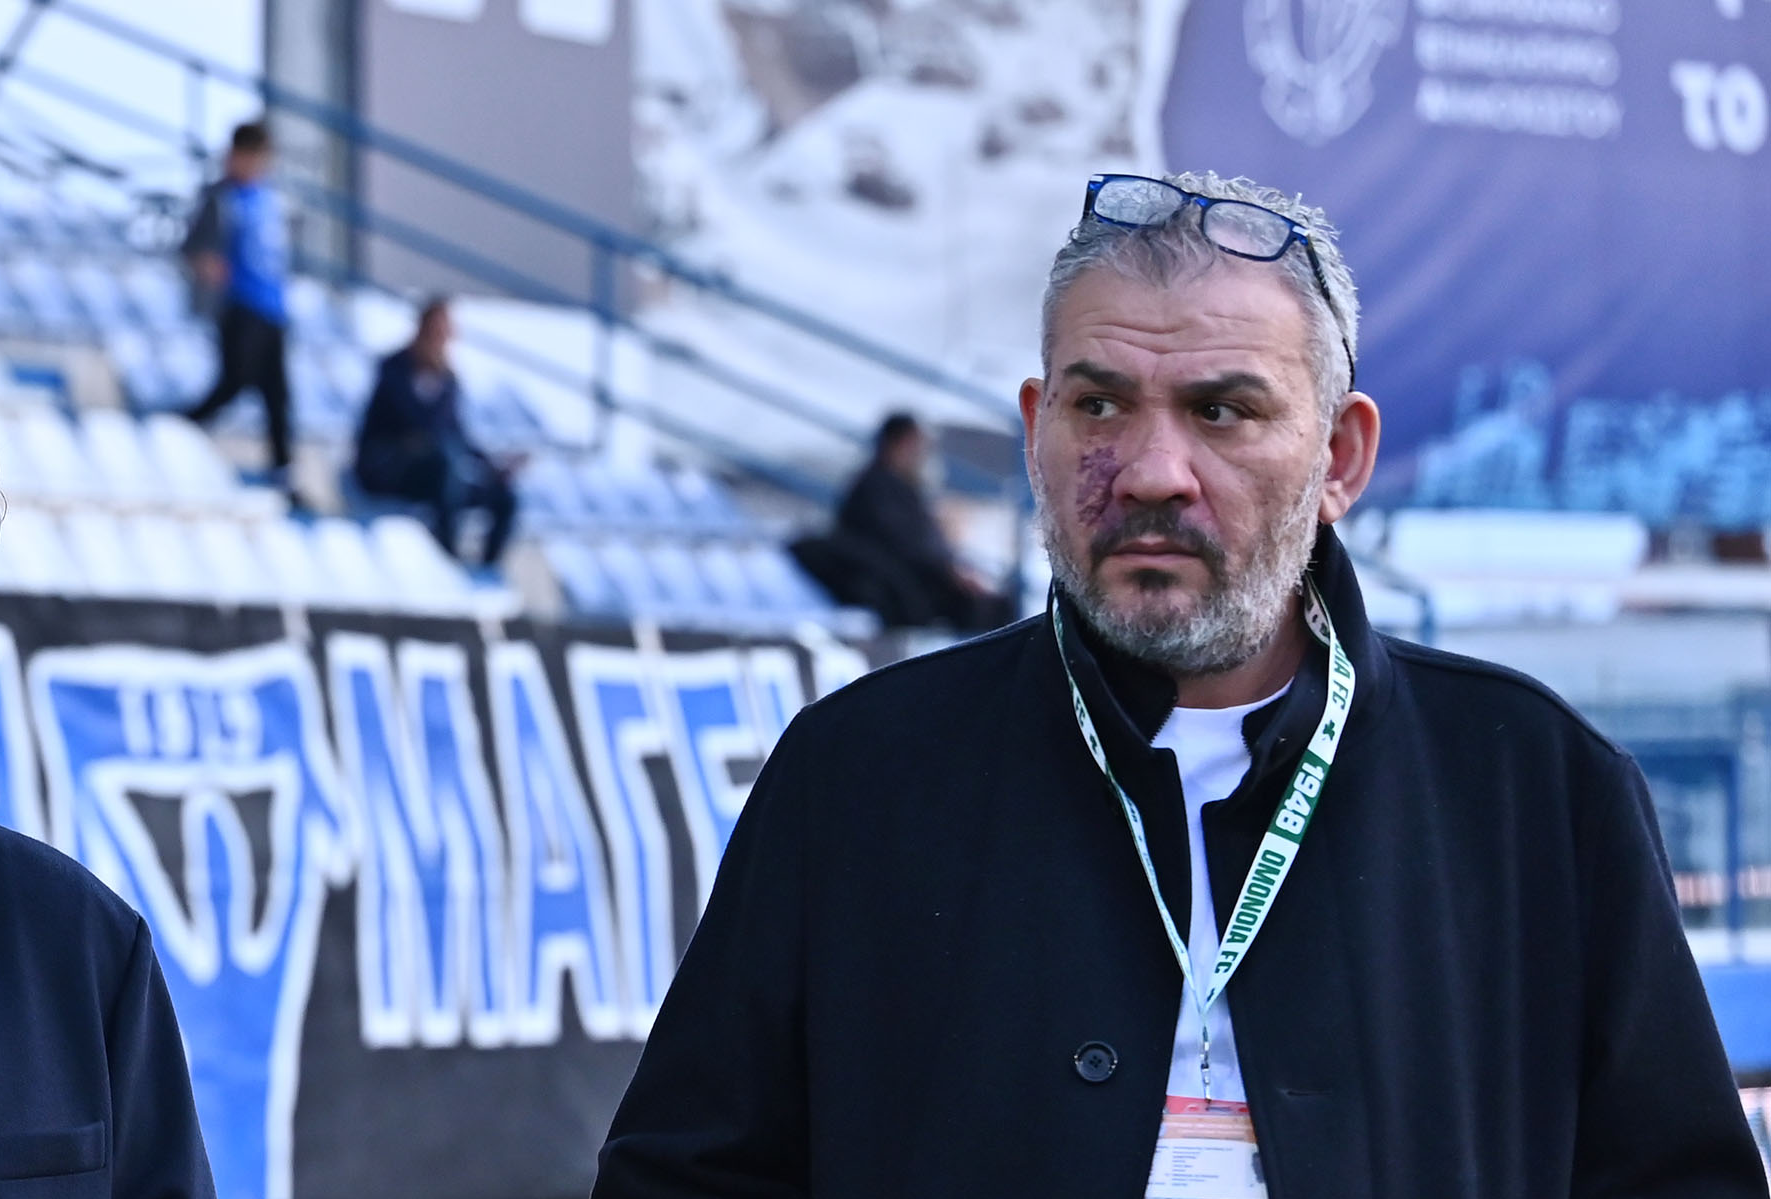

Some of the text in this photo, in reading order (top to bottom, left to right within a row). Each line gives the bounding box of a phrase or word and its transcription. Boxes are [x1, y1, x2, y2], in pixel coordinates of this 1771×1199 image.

[1214, 762, 1324, 975] 1948 OMONOIA FC
